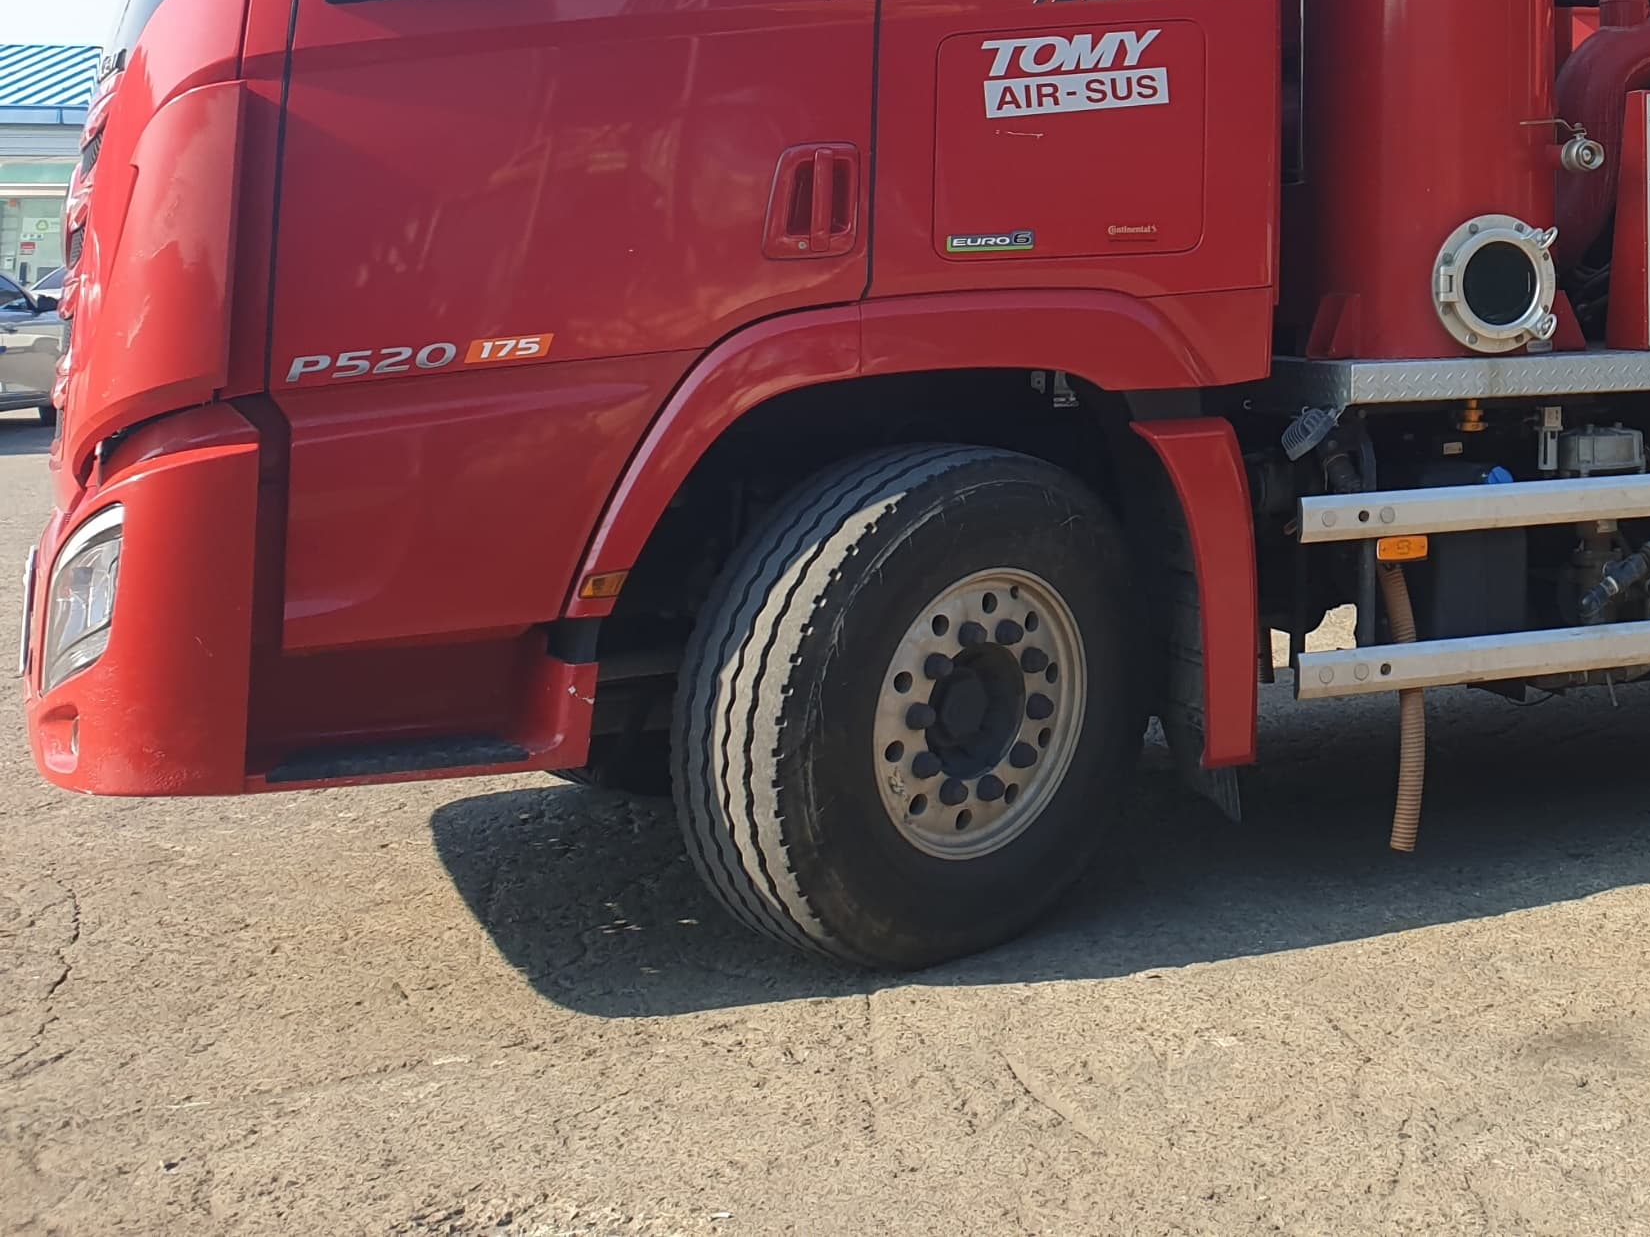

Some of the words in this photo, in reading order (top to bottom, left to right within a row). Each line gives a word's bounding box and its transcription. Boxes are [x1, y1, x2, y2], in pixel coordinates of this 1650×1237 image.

[981, 29, 1163, 77] TOMY
[286, 342, 457, 382] P520
[480, 337, 541, 359] 175
